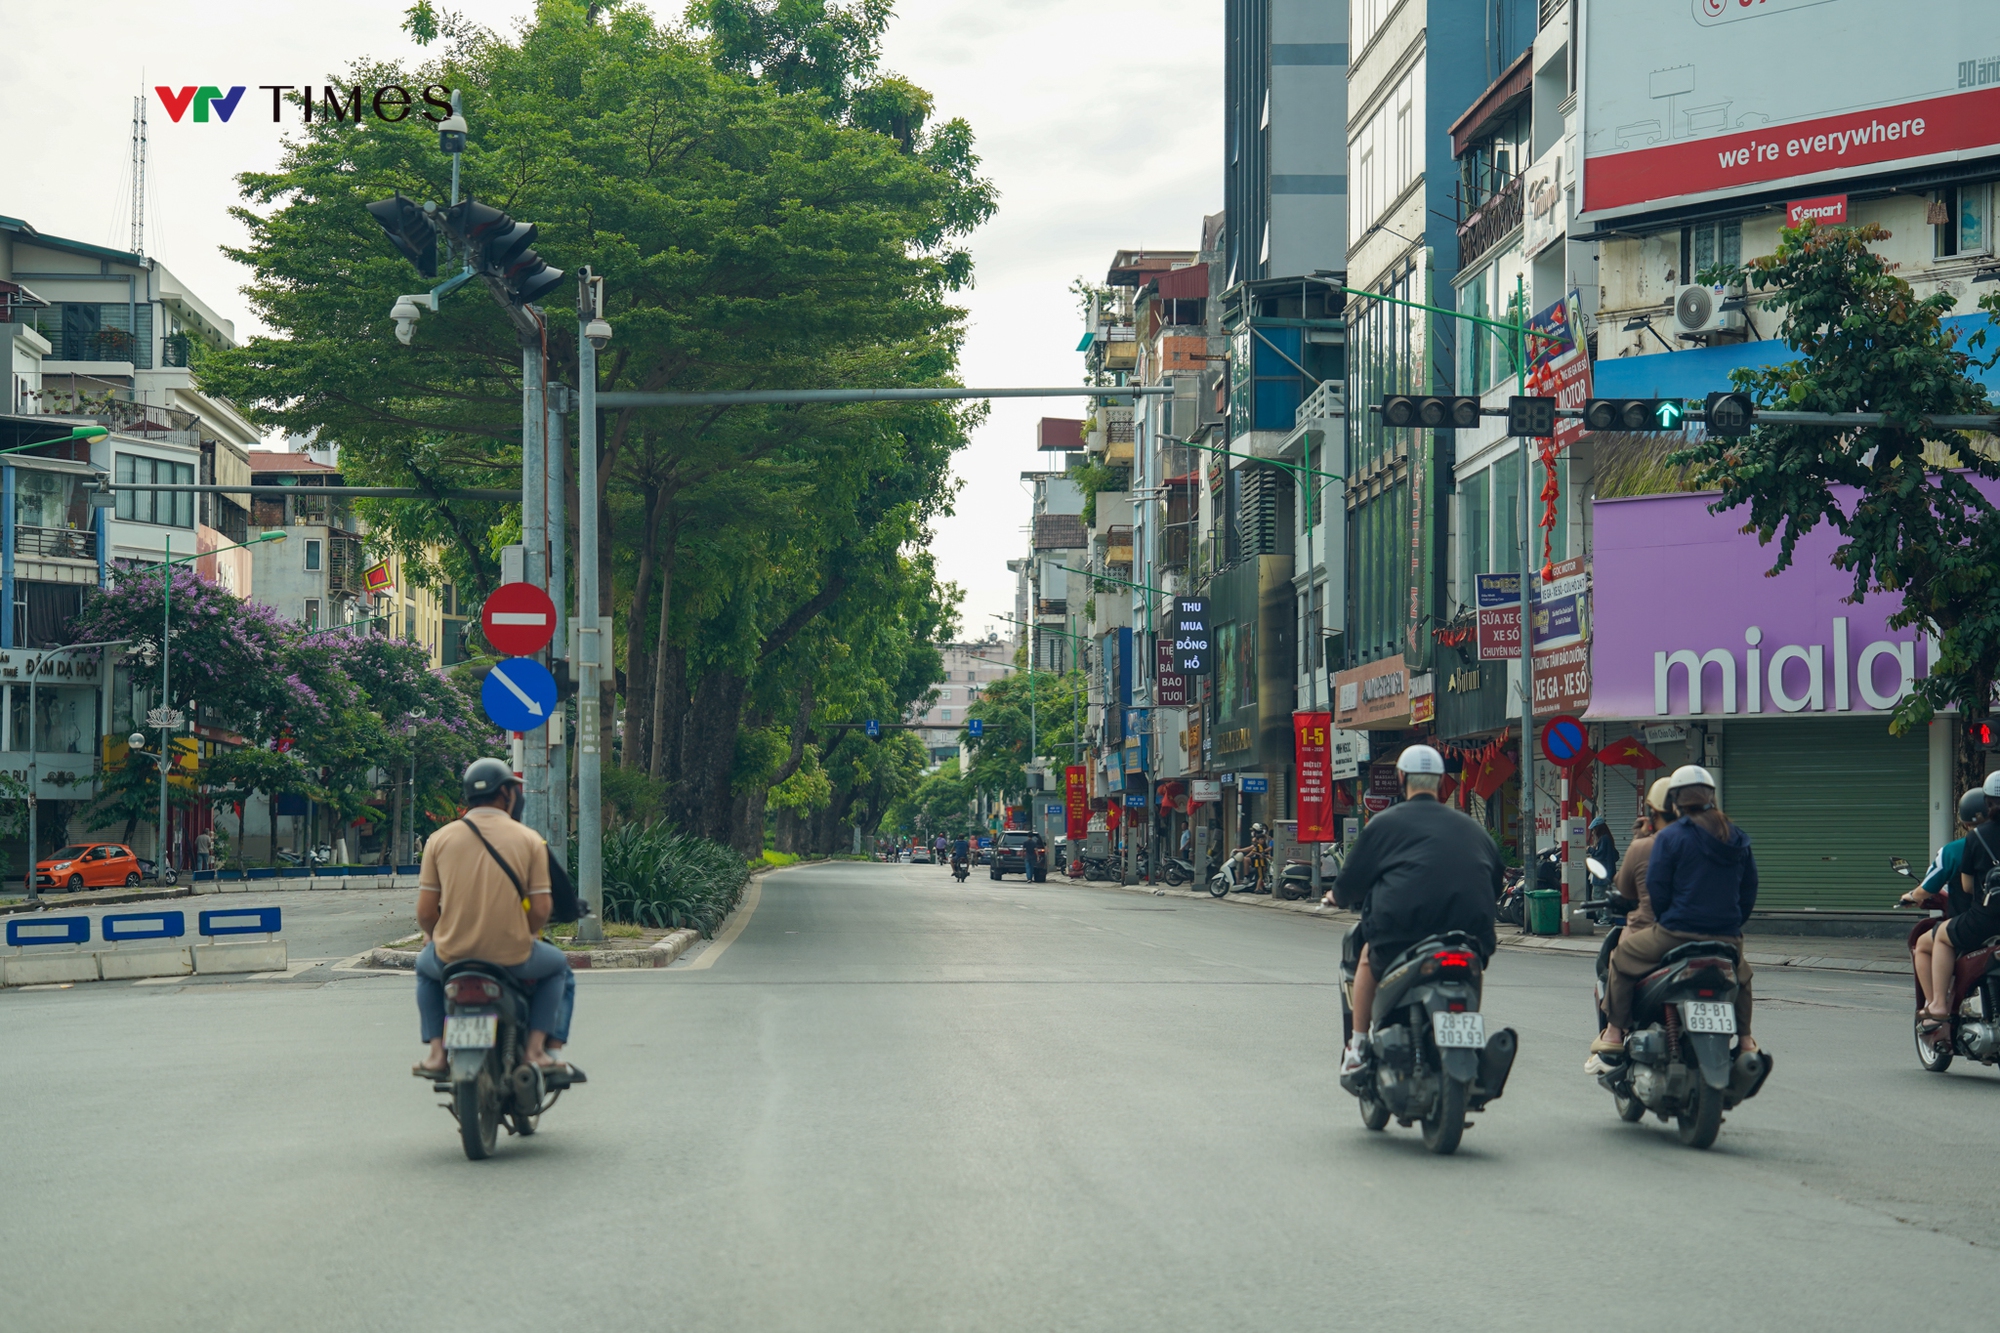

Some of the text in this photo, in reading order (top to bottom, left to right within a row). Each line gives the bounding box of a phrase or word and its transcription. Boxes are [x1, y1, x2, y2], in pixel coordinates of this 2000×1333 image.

[1786, 117, 1926, 155] everywhere
[1559, 378, 1587, 408] MOTOR
[1182, 602, 1201, 612] THU
[1481, 611, 1500, 625] SỬA
[1502, 613, 1515, 624] XE
[1181, 621, 1203, 631] MUA
[1493, 626, 1520, 641] XE SỐ
[1176, 636, 1207, 650] ĐỒNG
[1160, 645, 1174, 658] TIỆ
[1482, 645, 1508, 657] CHUYÊN
[1160, 661, 1174, 673] BÁ
[1184, 655, 1200, 669] HỒ
[57, 661, 73, 680] DẠ
[1162, 677, 1182, 687] BAO
[1535, 679, 1546, 701] XE
[1546, 676, 1559, 699] GA
[1563, 672, 1575, 696] XE
[1575, 662, 1587, 694] SỐ
[1162, 691, 1183, 701] TƯƠI
[1301, 727, 1324, 745] 1-5
[1070, 774, 1084, 784] 30-4
[1693, 1003, 1726, 1017] 29-B1
[1690, 1017, 1732, 1031] 893.13
[1439, 1030, 1482, 1045] 303.93
